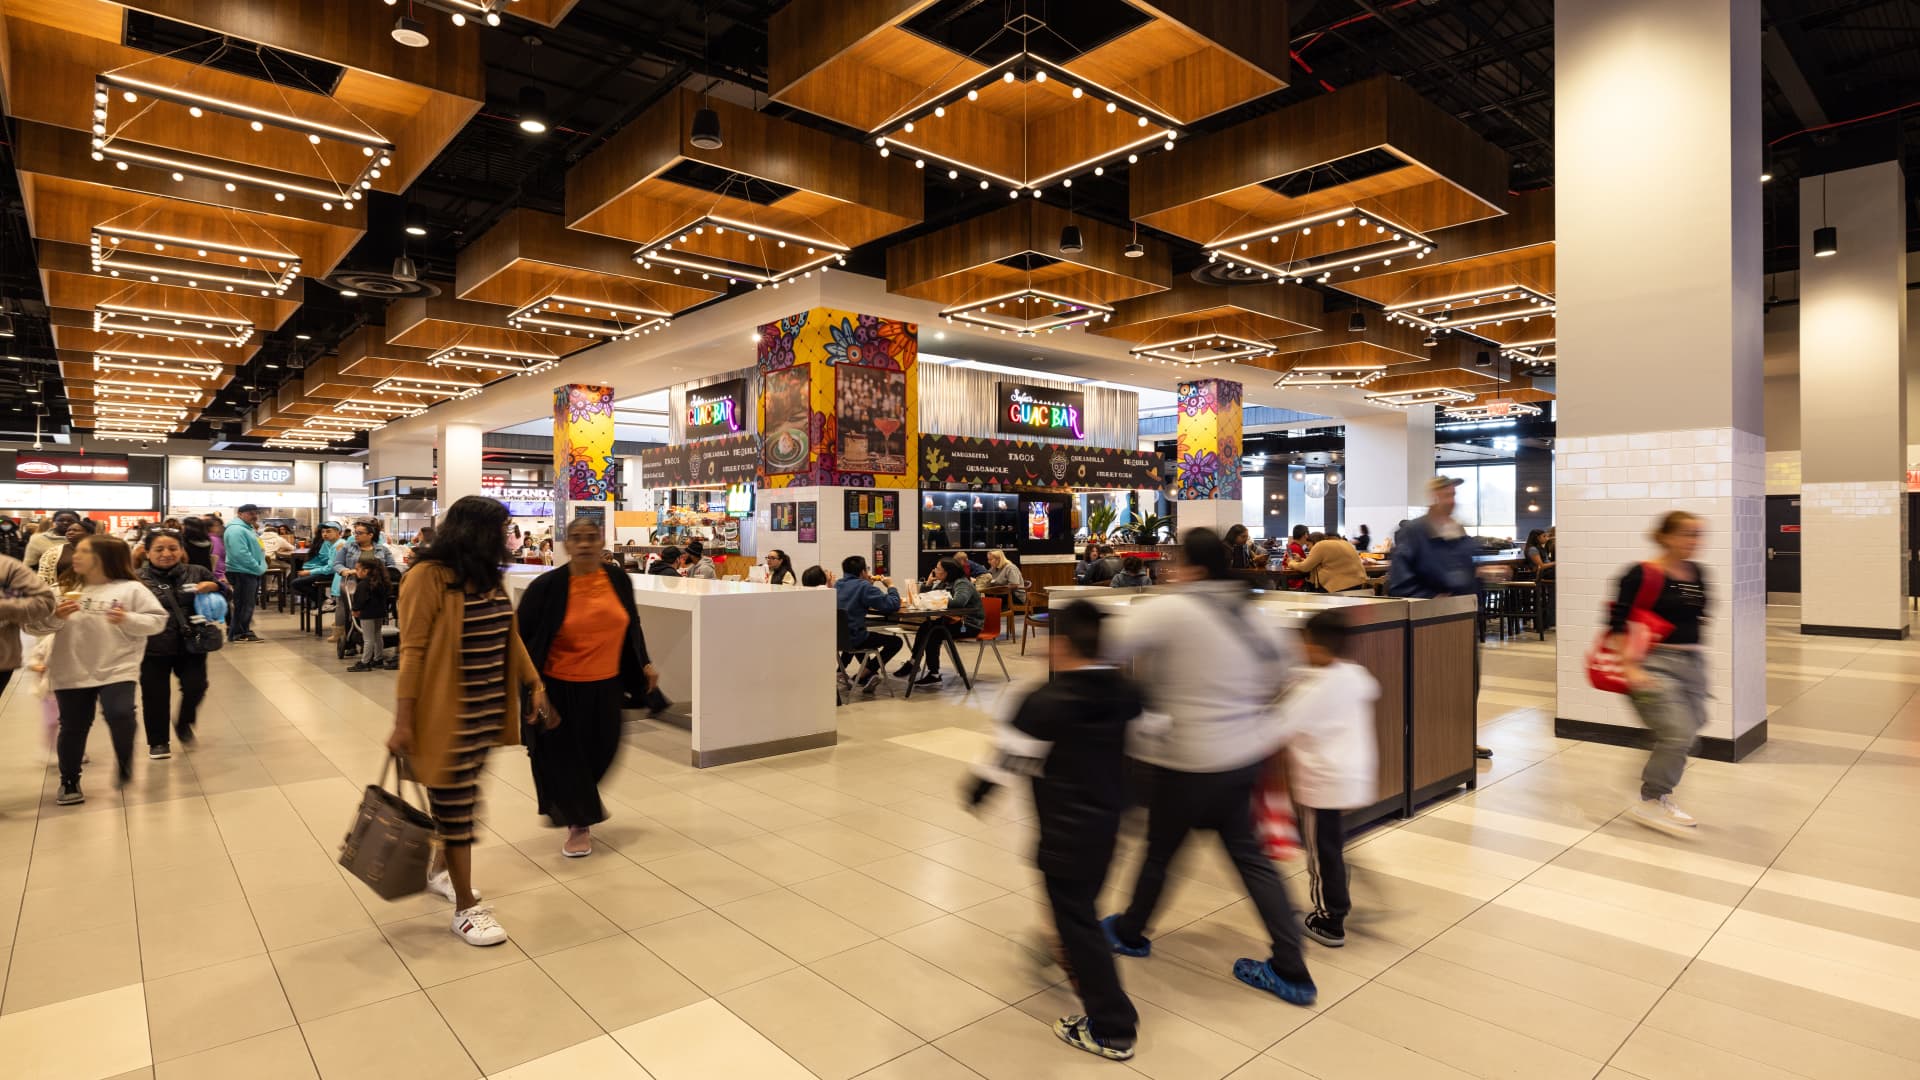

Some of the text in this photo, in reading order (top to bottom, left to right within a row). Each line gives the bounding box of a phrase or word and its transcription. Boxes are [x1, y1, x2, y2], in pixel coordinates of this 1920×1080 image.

[688, 404, 712, 426] GUAC
[713, 399, 738, 431] BAR
[1010, 403, 1084, 439] GUAC BAR
[1008, 453, 1035, 462] TACOS
[1123, 458, 1149, 467] TEQUILA
[966, 464, 1009, 474] GUACAMOLE
[210, 467, 290, 482] MELT SHOP
[504, 488, 547, 497] ISLAND
